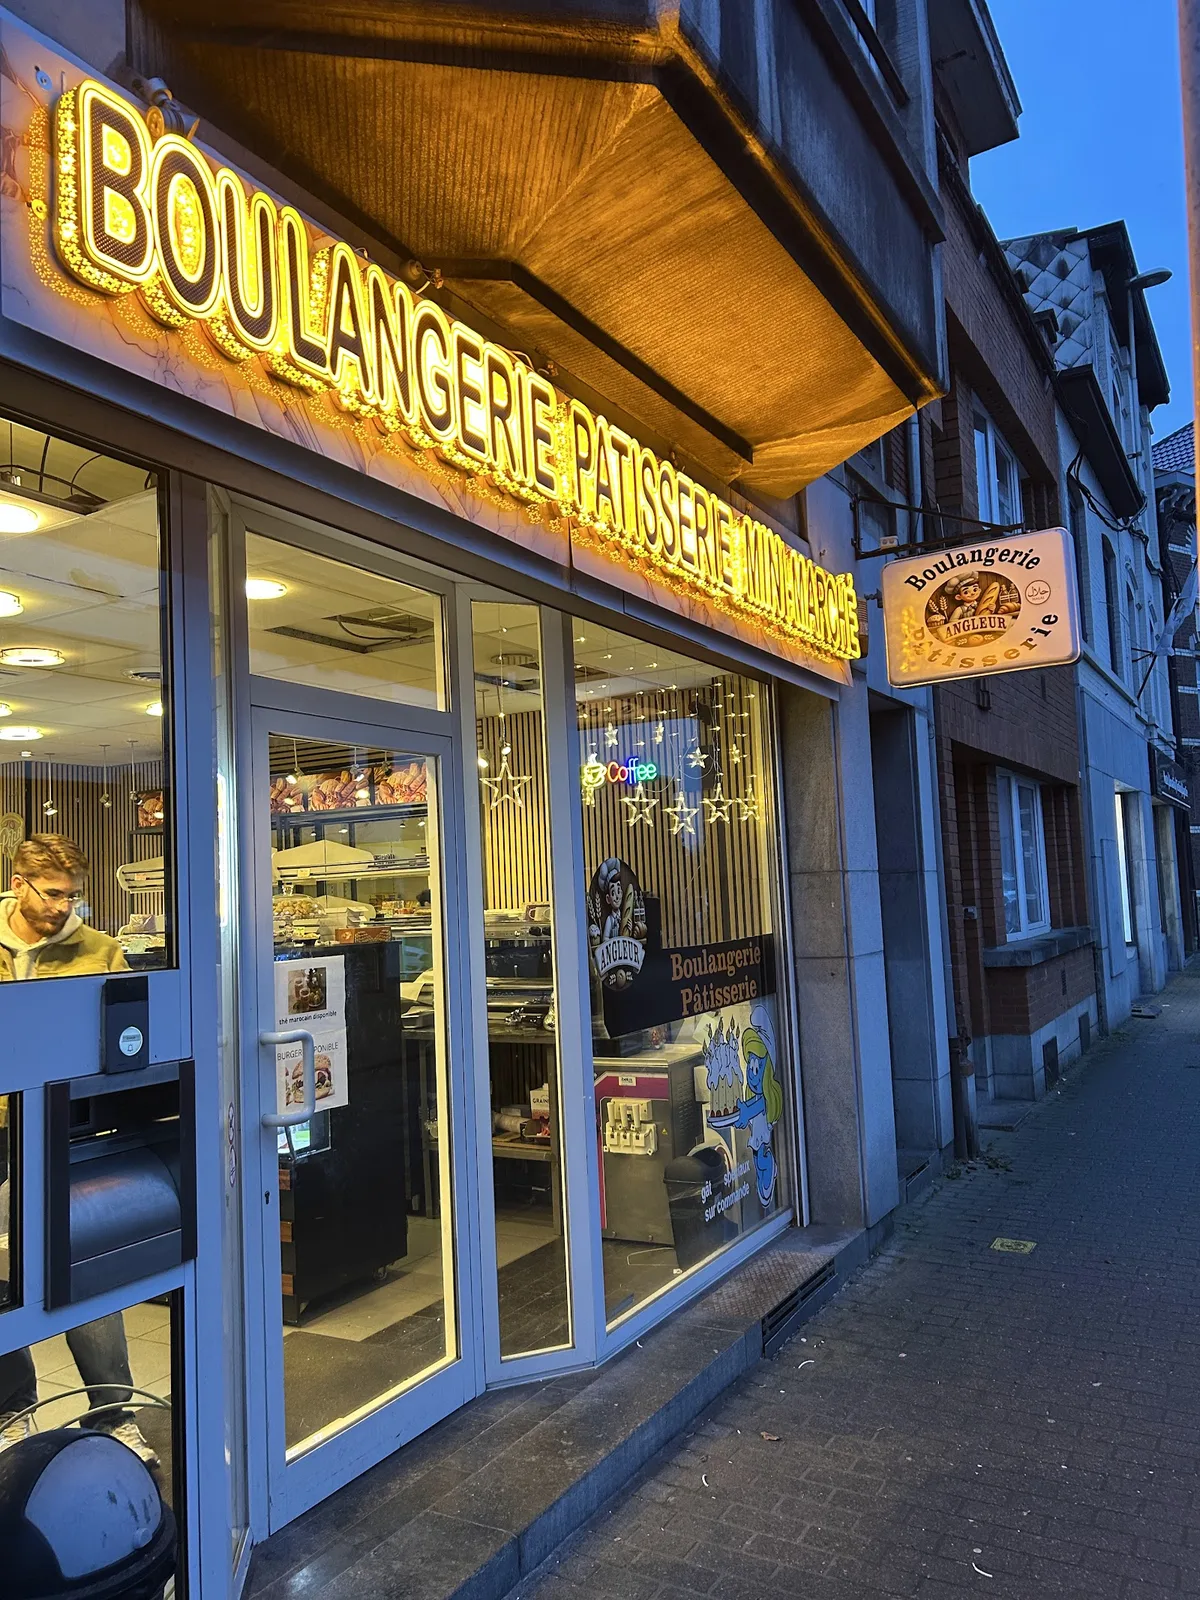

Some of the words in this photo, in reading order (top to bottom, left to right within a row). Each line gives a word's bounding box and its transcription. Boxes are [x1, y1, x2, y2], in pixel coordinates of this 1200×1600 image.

[66, 79, 560, 505] BOULANGERIE
[569, 398, 735, 595] PATISSERIE
[904, 547, 1041, 592] Boulangerie
[945, 615, 1007, 639] ANGLEUR
[607, 756, 658, 785] Coffee
[600, 939, 640, 972] ANGLEUR
[670, 941, 761, 981] Boulangerie
[681, 975, 758, 1016] Pâtisserie
[289, 1015, 312, 1023] marocain
[313, 1010, 337, 1019] disponible
[277, 1049, 303, 1060] BURGER
[313, 1041, 338, 1053] PONIBLE
[704, 1203, 717, 1222] sur
[717, 1180, 750, 1214] commande
